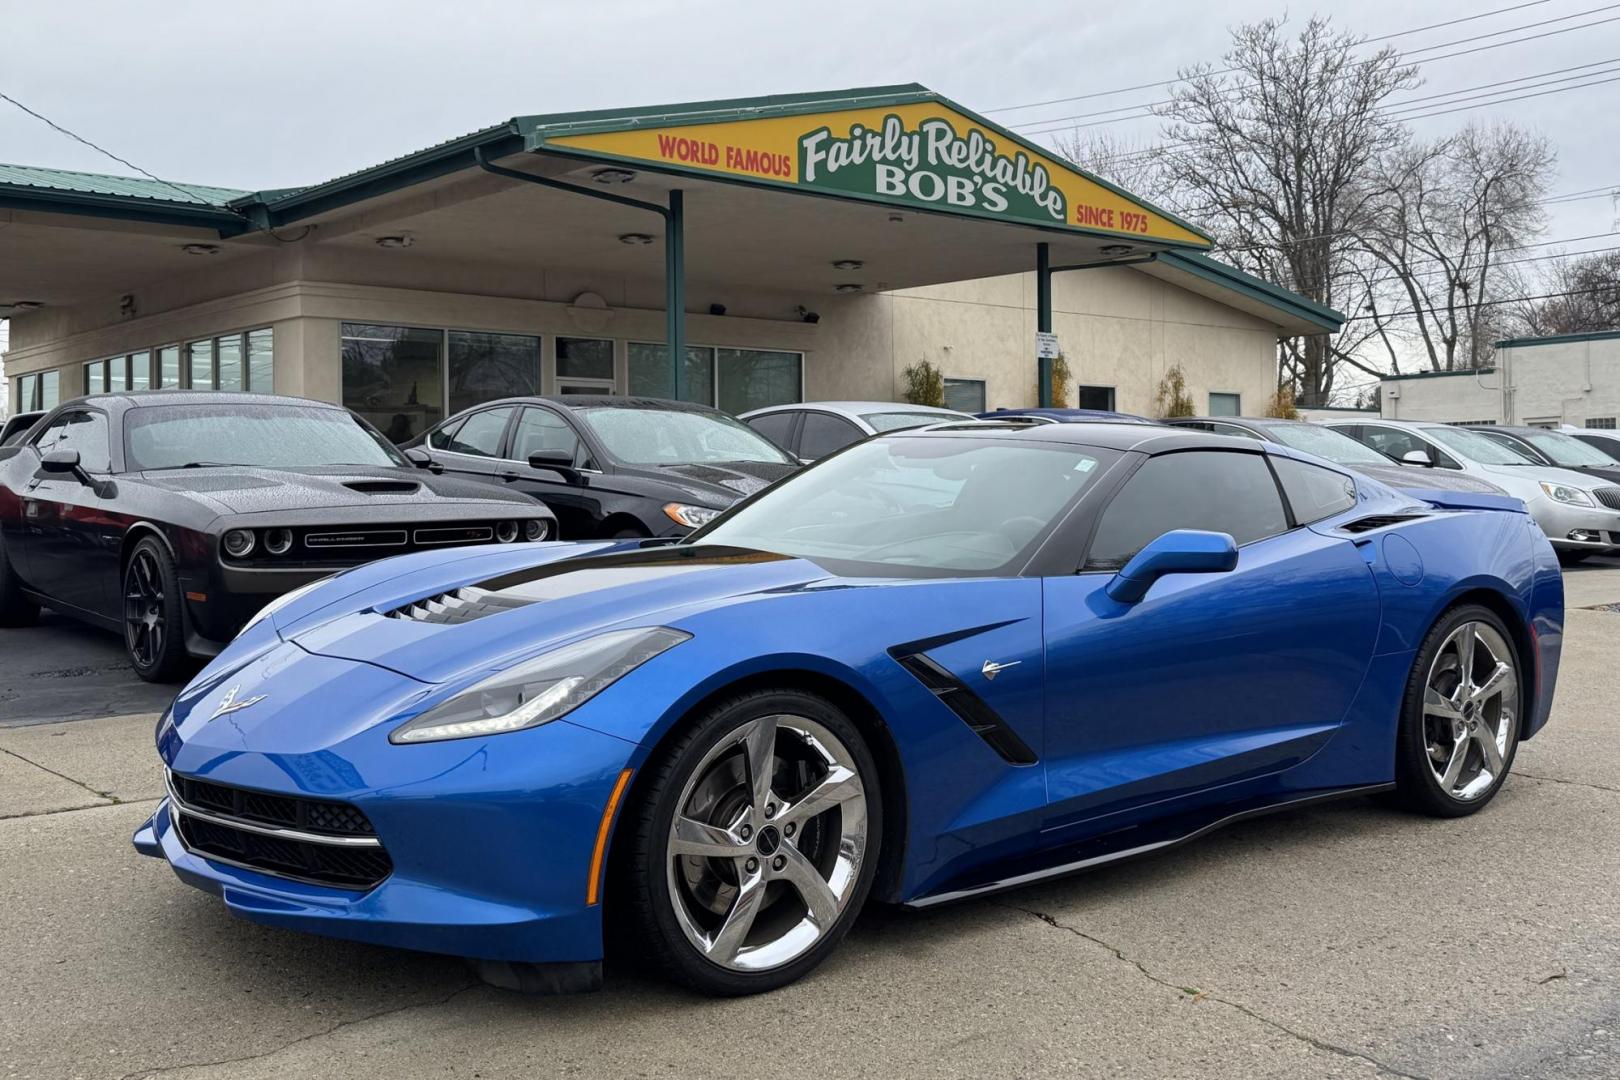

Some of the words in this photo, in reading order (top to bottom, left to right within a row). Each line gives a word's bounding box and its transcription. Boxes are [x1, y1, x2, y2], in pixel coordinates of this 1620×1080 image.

[658, 134, 719, 166] WORLD
[725, 146, 791, 177] FAMOUS
[802, 117, 920, 182] Fairly
[922, 120, 1065, 220] Reliable
[875, 163, 1009, 212] BOB'S
[1076, 204, 1114, 229] SINCE
[1119, 211, 1148, 233] 1975
